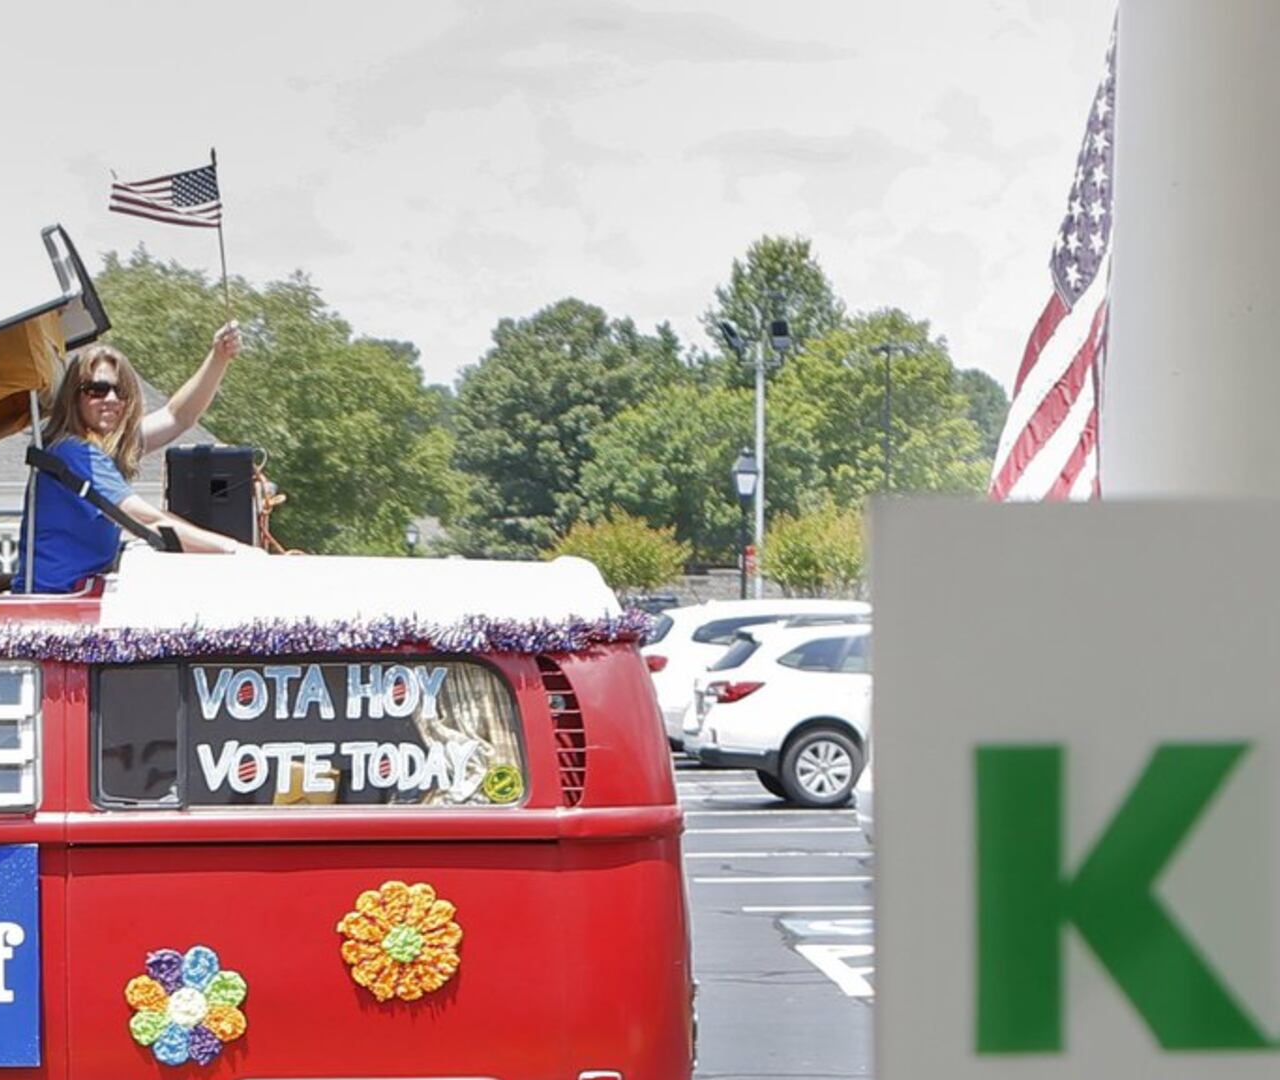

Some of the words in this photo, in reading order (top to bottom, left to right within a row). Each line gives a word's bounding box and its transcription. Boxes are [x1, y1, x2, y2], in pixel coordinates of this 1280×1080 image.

[193, 664, 335, 720] VOTA
[346, 664, 448, 719] HOY
[197, 740, 336, 793] VOTE
[340, 741, 480, 796] TODAY
